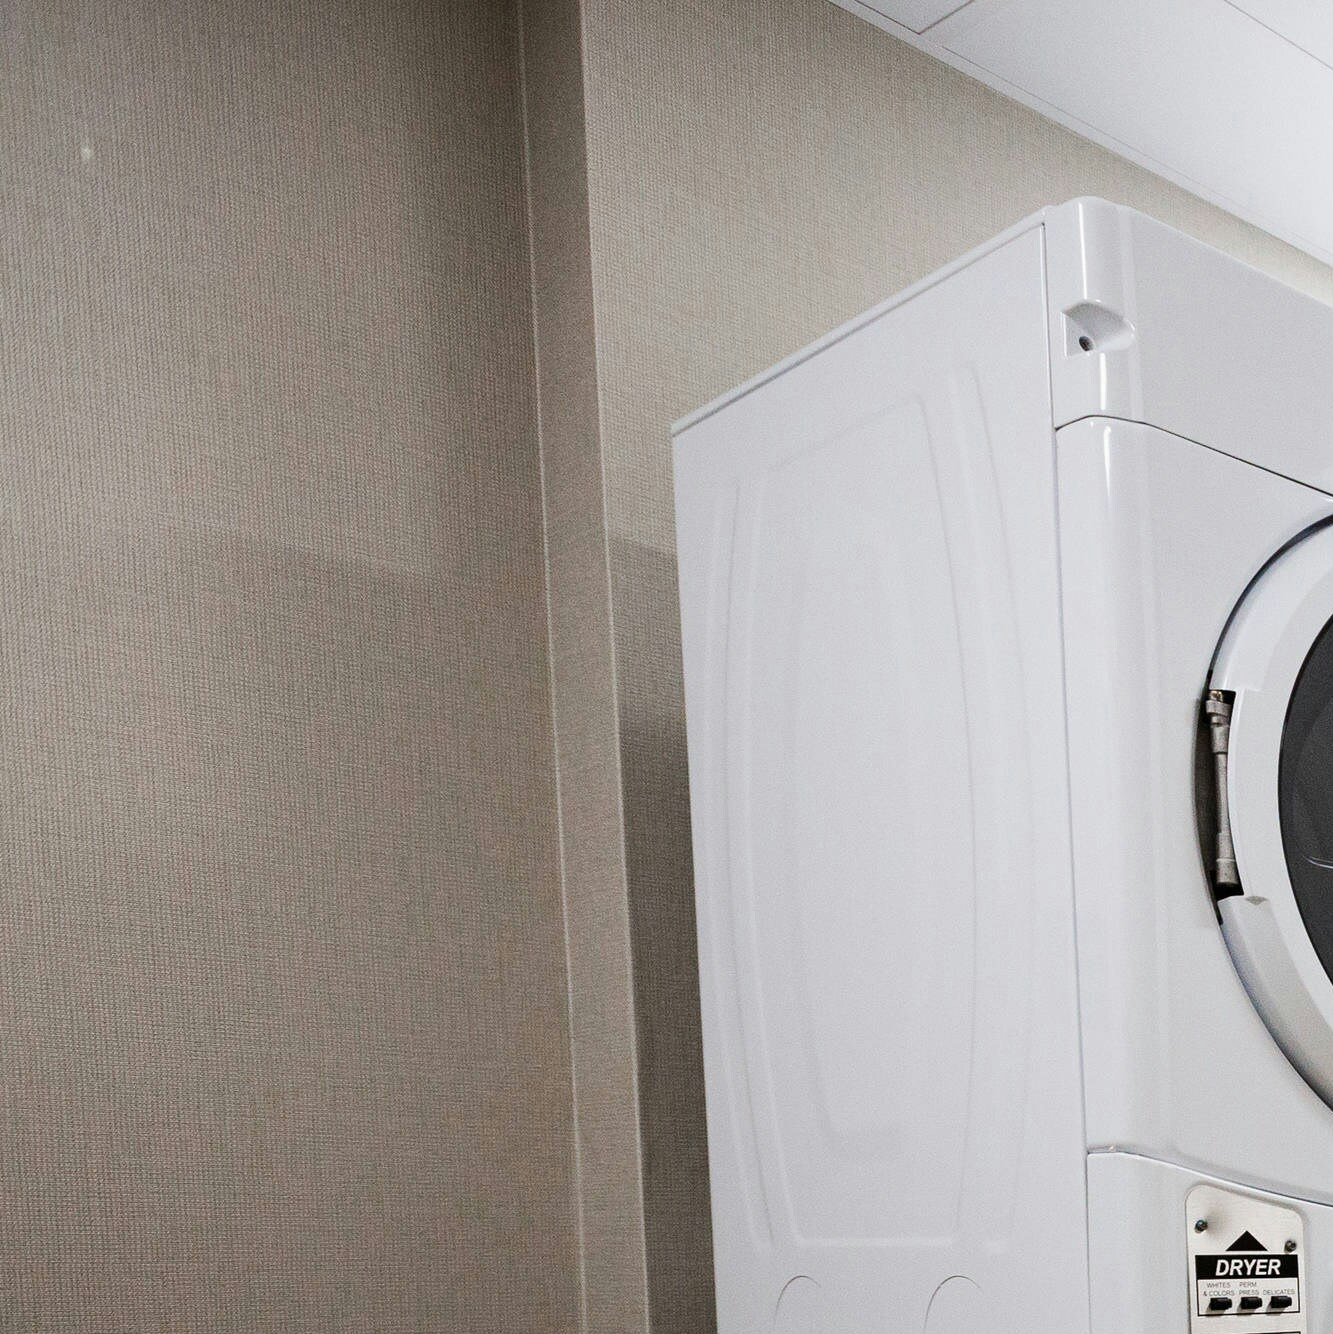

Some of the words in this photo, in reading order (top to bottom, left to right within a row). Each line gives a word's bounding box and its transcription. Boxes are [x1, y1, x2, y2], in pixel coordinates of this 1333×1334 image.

[1215, 1258, 1281, 1276] DRYER
[1208, 1289, 1235, 1297] COLORS
[1262, 1288, 1296, 1296] DELICATES
